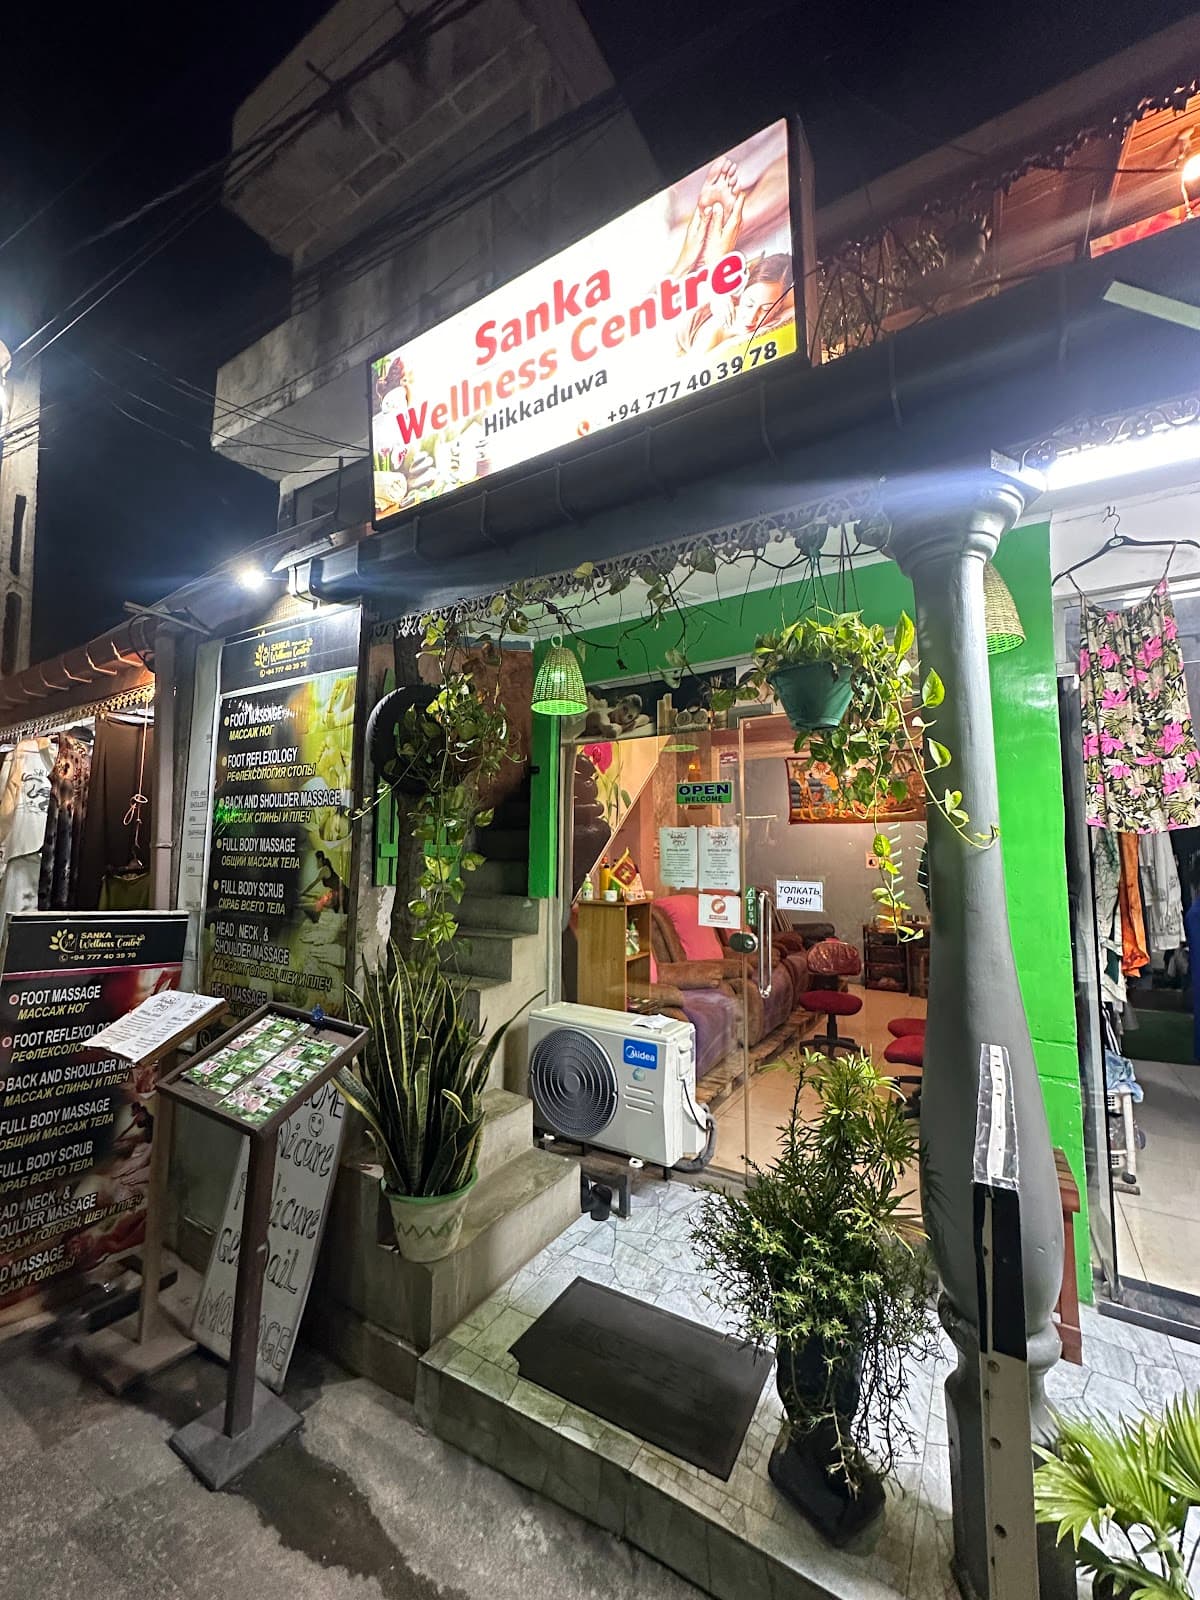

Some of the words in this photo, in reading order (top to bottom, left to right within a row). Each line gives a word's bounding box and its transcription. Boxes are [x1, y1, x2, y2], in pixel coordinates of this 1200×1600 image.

[475, 268, 610, 366] Sanka
[396, 347, 557, 445] Wellness
[569, 253, 744, 363] Centre
[607, 398, 641, 423] +94
[645, 382, 681, 408] 777
[686, 369, 712, 392] 40
[716, 356, 743, 381] 39
[749, 341, 778, 366] 78
[484, 368, 608, 437] Hikkaduwa
[230, 711, 248, 727] FOOT
[248, 705, 284, 725] MASSAGE
[229, 726, 259, 741] МАССАЖ
[259, 724, 275, 738] НОГ
[227, 753, 246, 768] FOOT
[246, 747, 298, 768] REFLEXOLOGY
[287, 763, 316, 778] СТОПЫ
[225, 795, 245, 809] BACK
[244, 794, 259, 809] AND
[260, 792, 299, 808] SHOULDER
[300, 789, 341, 806] MASSAGE
[679, 783, 729, 796] OPEN
[255, 811, 281, 824] СПИНЫ
[282, 811, 289, 822] И
[290, 809, 312, 823] ПЛЕЧ
[222, 837, 239, 851] FULL
[240, 838, 259, 852] BODY
[260, 837, 296, 853] MASSAGE
[221, 854, 247, 869] ОБЩИЙ
[247, 856, 279, 868] МАССАЖ
[280, 857, 300, 869] ТЕЛА
[221, 880, 237, 895] FULL
[238, 881, 258, 896] BODY
[259, 882, 284, 898] SCRUB
[779, 885, 821, 897] ТОЛКАТЬ
[218, 898, 240, 911] СКРАБ
[240, 900, 265, 913] ВСЕГО
[266, 902, 286, 915] ТЕЛА
[786, 896, 812, 906] PUSH
[747, 898, 755, 926] PUSH
[216, 921, 235, 938] HEAD
[238, 923, 259, 941] NECK
[263, 927, 269, 942] &
[79, 939, 115, 949] Wellness
[214, 939, 252, 960] SHOULDER
[251, 943, 289, 965] MASSAGE
[306, 975, 332, 992] ПЛЕЧ
[20, 989, 51, 1006] FOOT
[52, 985, 101, 1002] MASSAGE
[211, 983, 231, 1001] HEAD
[231, 986, 267, 1007] MASSAGE
[17, 1004, 67, 1020] МАССАЖ
[67, 1002, 90, 1015] НОГ
[13, 1031, 44, 1049] FOOT
[626, 1045, 656, 1063] Midea
[6, 1073, 39, 1092] BACK
[40, 1068, 62, 1086] AND
[64, 1059, 116, 1081] SHOULDER
[4, 1087, 54, 1107] МАССАЖ
[55, 1081, 93, 1097] СПИНЫ
[94, 1079, 103, 1088] И
[104, 1072, 130, 1087] ПЛЕЧ
[0, 1116, 27, 1137] FULL
[30, 1109, 61, 1129] BODY
[62, 1098, 110, 1121] MASSAGE
[42, 1119, 88, 1139] МАССАЖ
[90, 1113, 114, 1128] ТЕЛА
[26, 1150, 58, 1172] BODY
[59, 1140, 93, 1162] SCRUB
[30, 1166, 66, 1186] ВСЕГО
[69, 1157, 94, 1173] ТЕЛА
[26, 1190, 56, 1213] NECK
[62, 1185, 70, 1200] &
[47, 1193, 97, 1222] MASSAGE
[11, 1244, 64, 1278] MASSAGE
